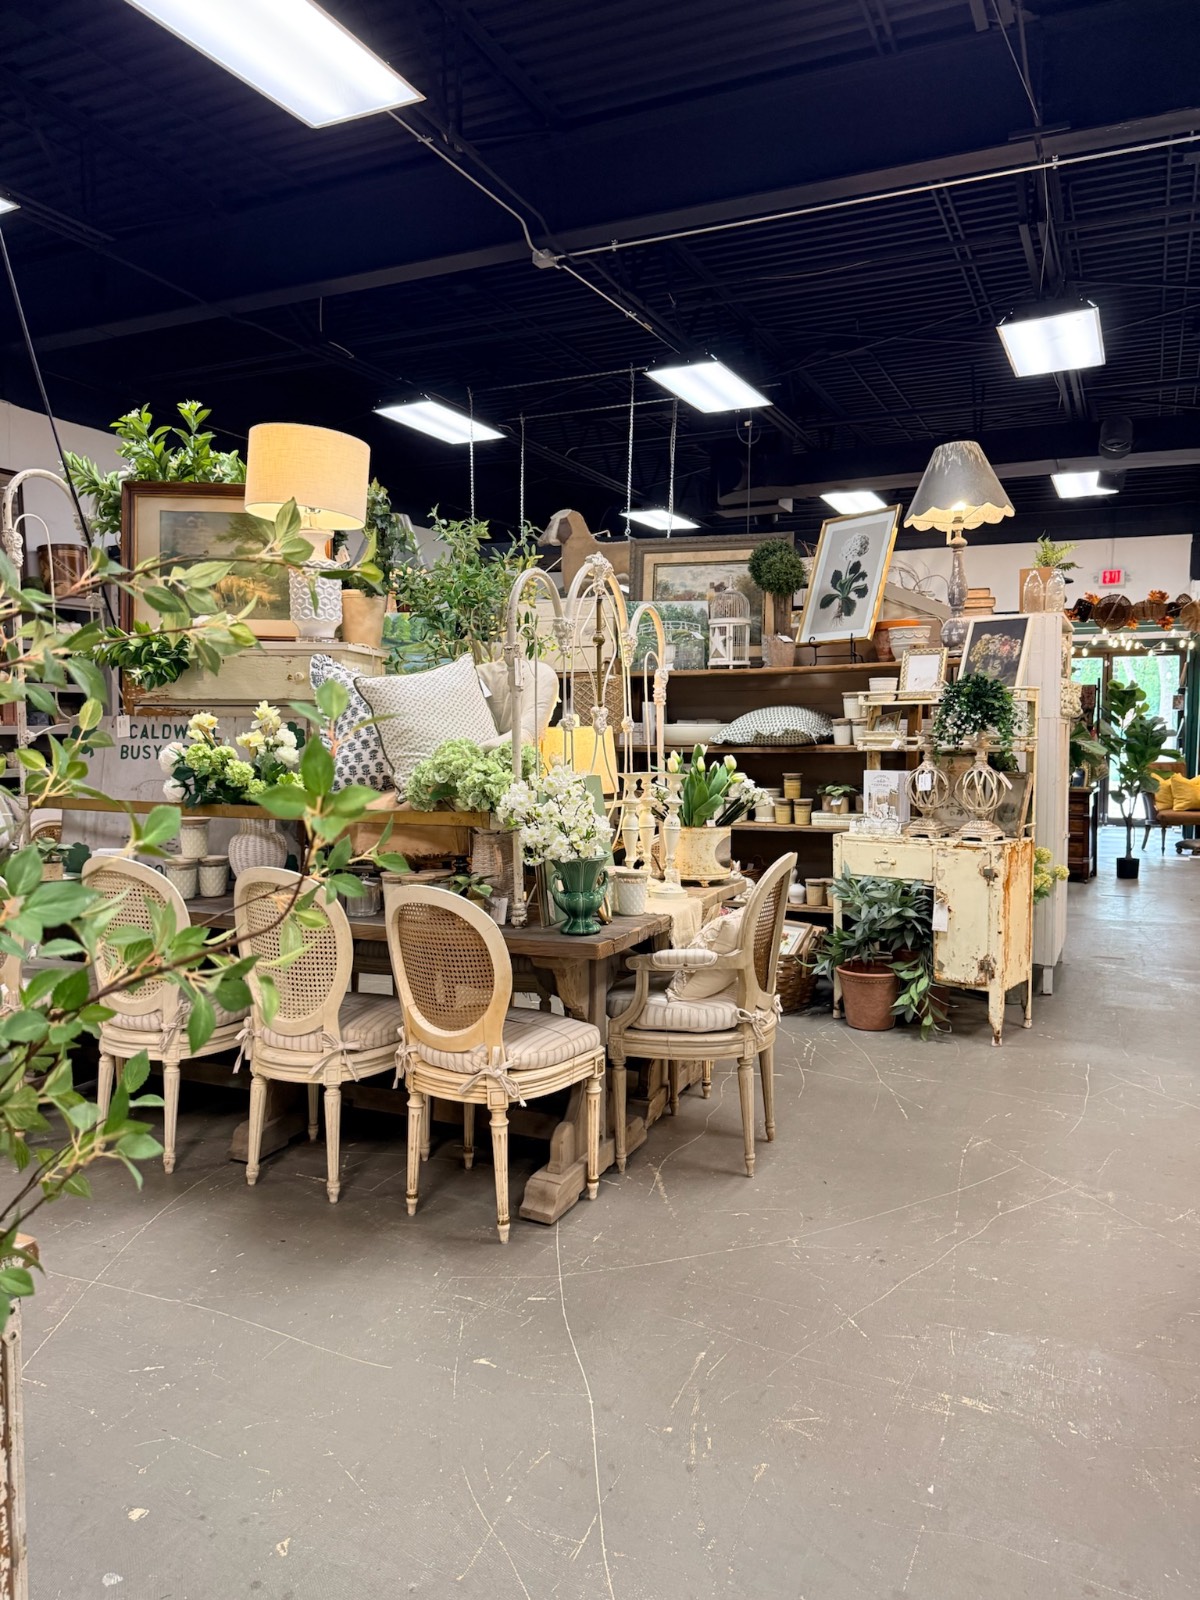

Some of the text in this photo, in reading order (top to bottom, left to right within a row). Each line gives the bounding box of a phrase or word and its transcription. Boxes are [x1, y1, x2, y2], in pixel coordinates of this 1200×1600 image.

[1103, 570, 1121, 584] EXIT
[130, 724, 221, 740] CALDWL
[120, 744, 162, 760] BUSY
